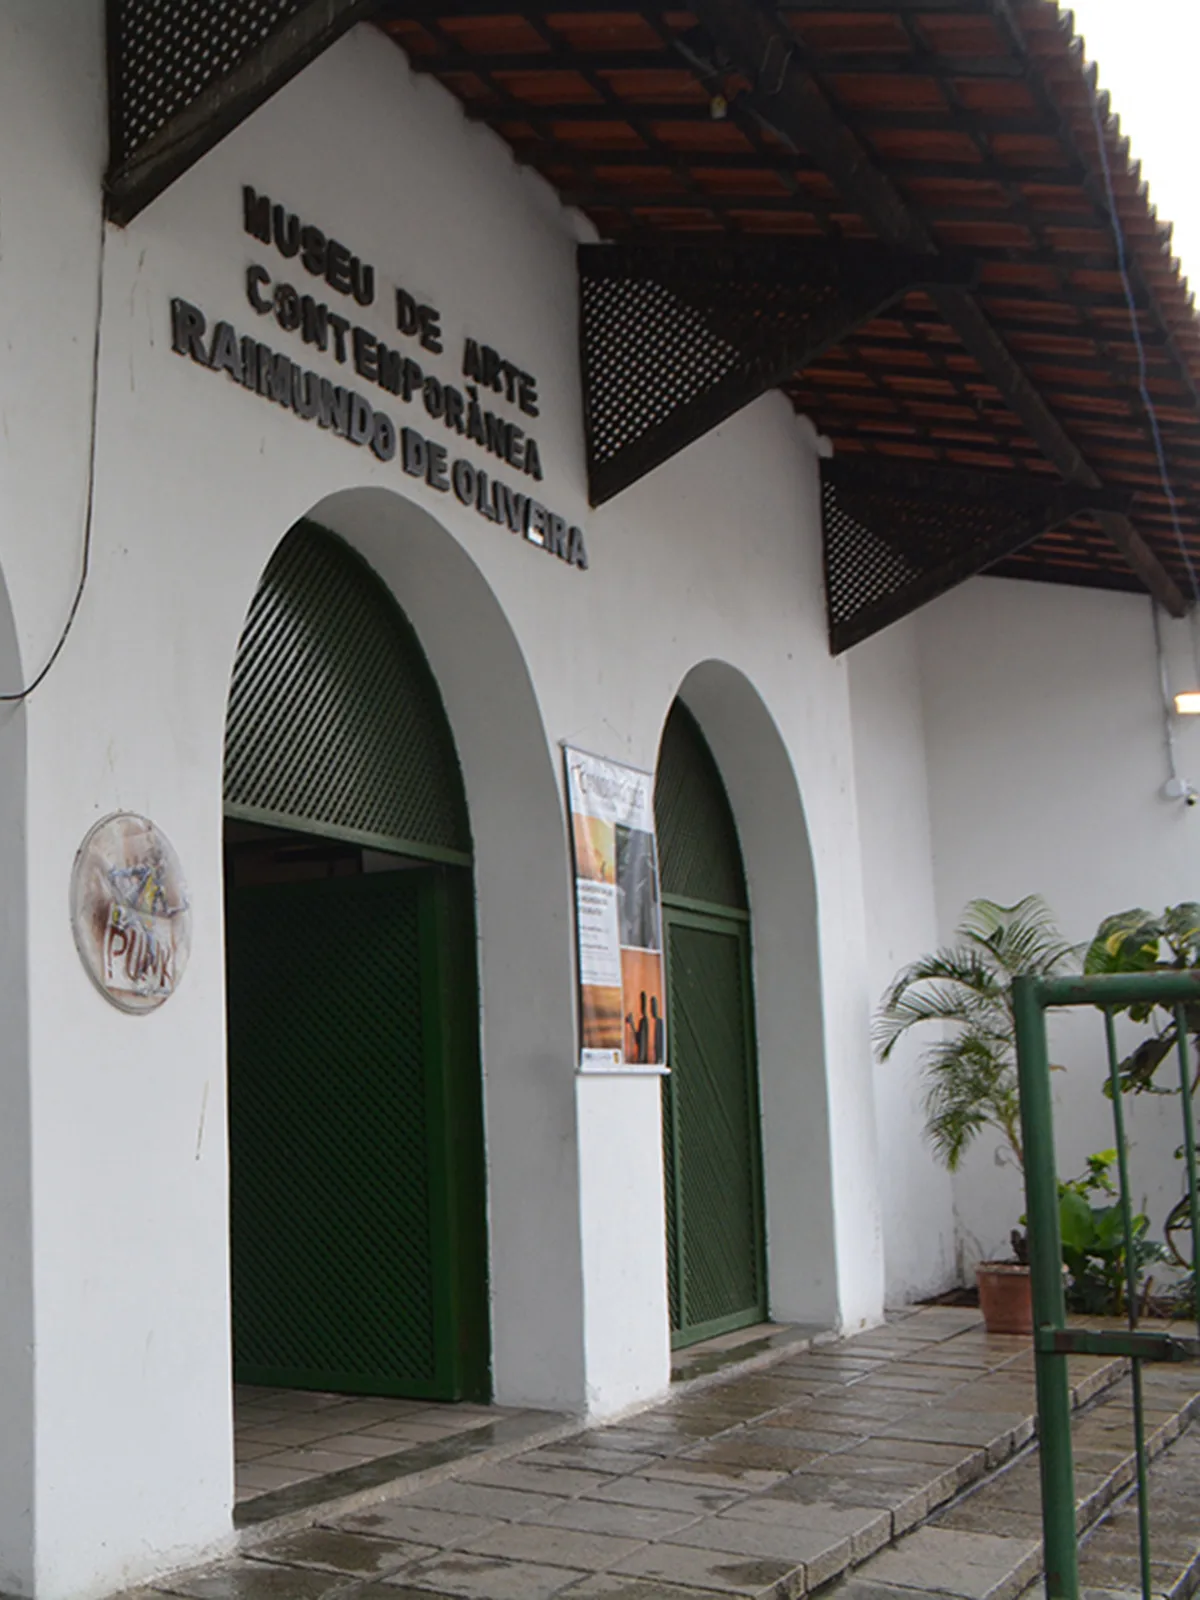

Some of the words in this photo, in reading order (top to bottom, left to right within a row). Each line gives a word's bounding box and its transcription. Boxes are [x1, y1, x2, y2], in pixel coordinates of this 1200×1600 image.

[243, 184, 374, 306] MUSEU
[396, 286, 443, 355] DE
[462, 337, 539, 417] ARTE
[171, 297, 397, 462] RAIMUNDO
[401, 426, 450, 492] DE
[452, 458, 588, 569] OLIVEIRA
[108, 924, 173, 987] PUNK
